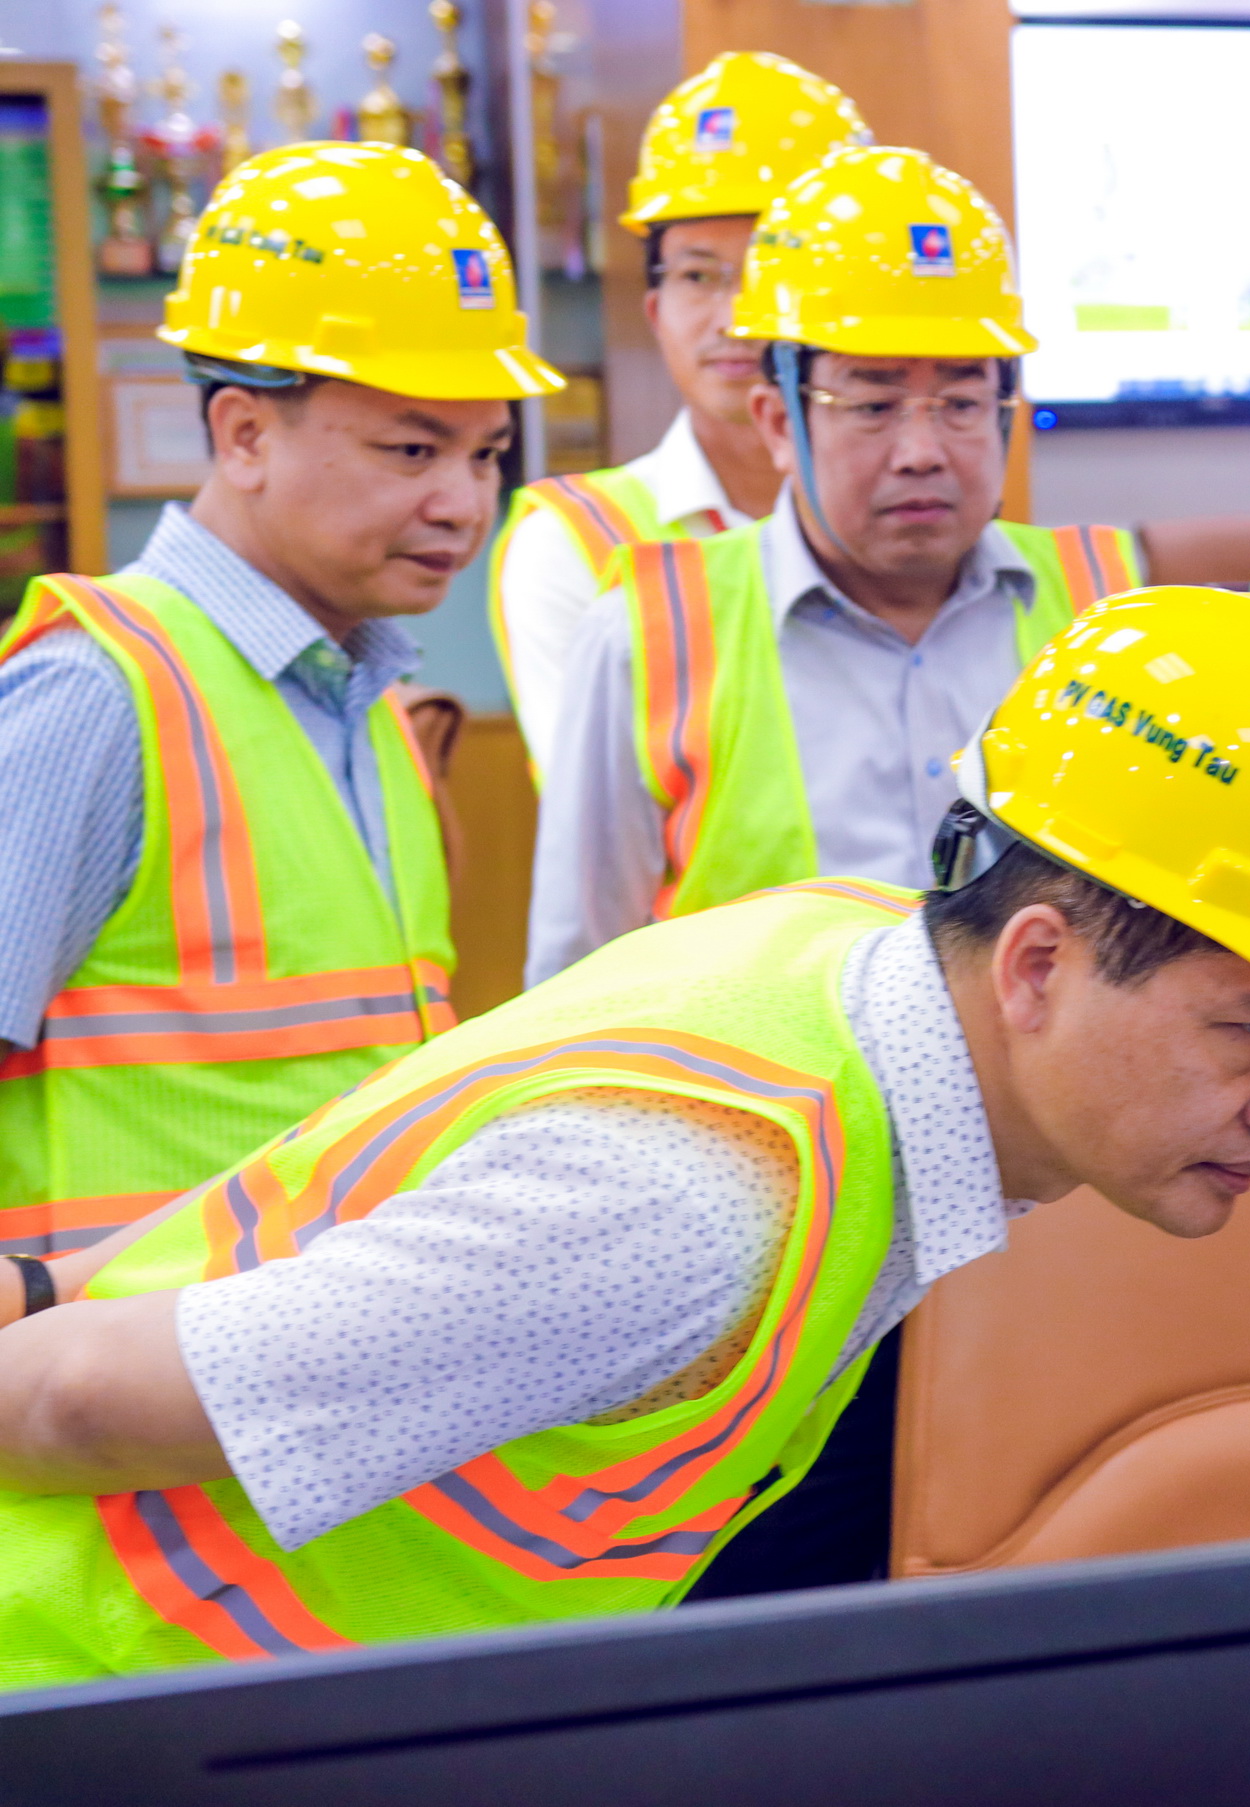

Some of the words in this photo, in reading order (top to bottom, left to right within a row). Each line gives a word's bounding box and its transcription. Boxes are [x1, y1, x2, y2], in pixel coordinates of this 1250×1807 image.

[1059, 680, 1092, 708] PV
[1085, 690, 1132, 728] GAS
[1132, 710, 1190, 764] Vung
[1194, 741, 1240, 786] Tau
